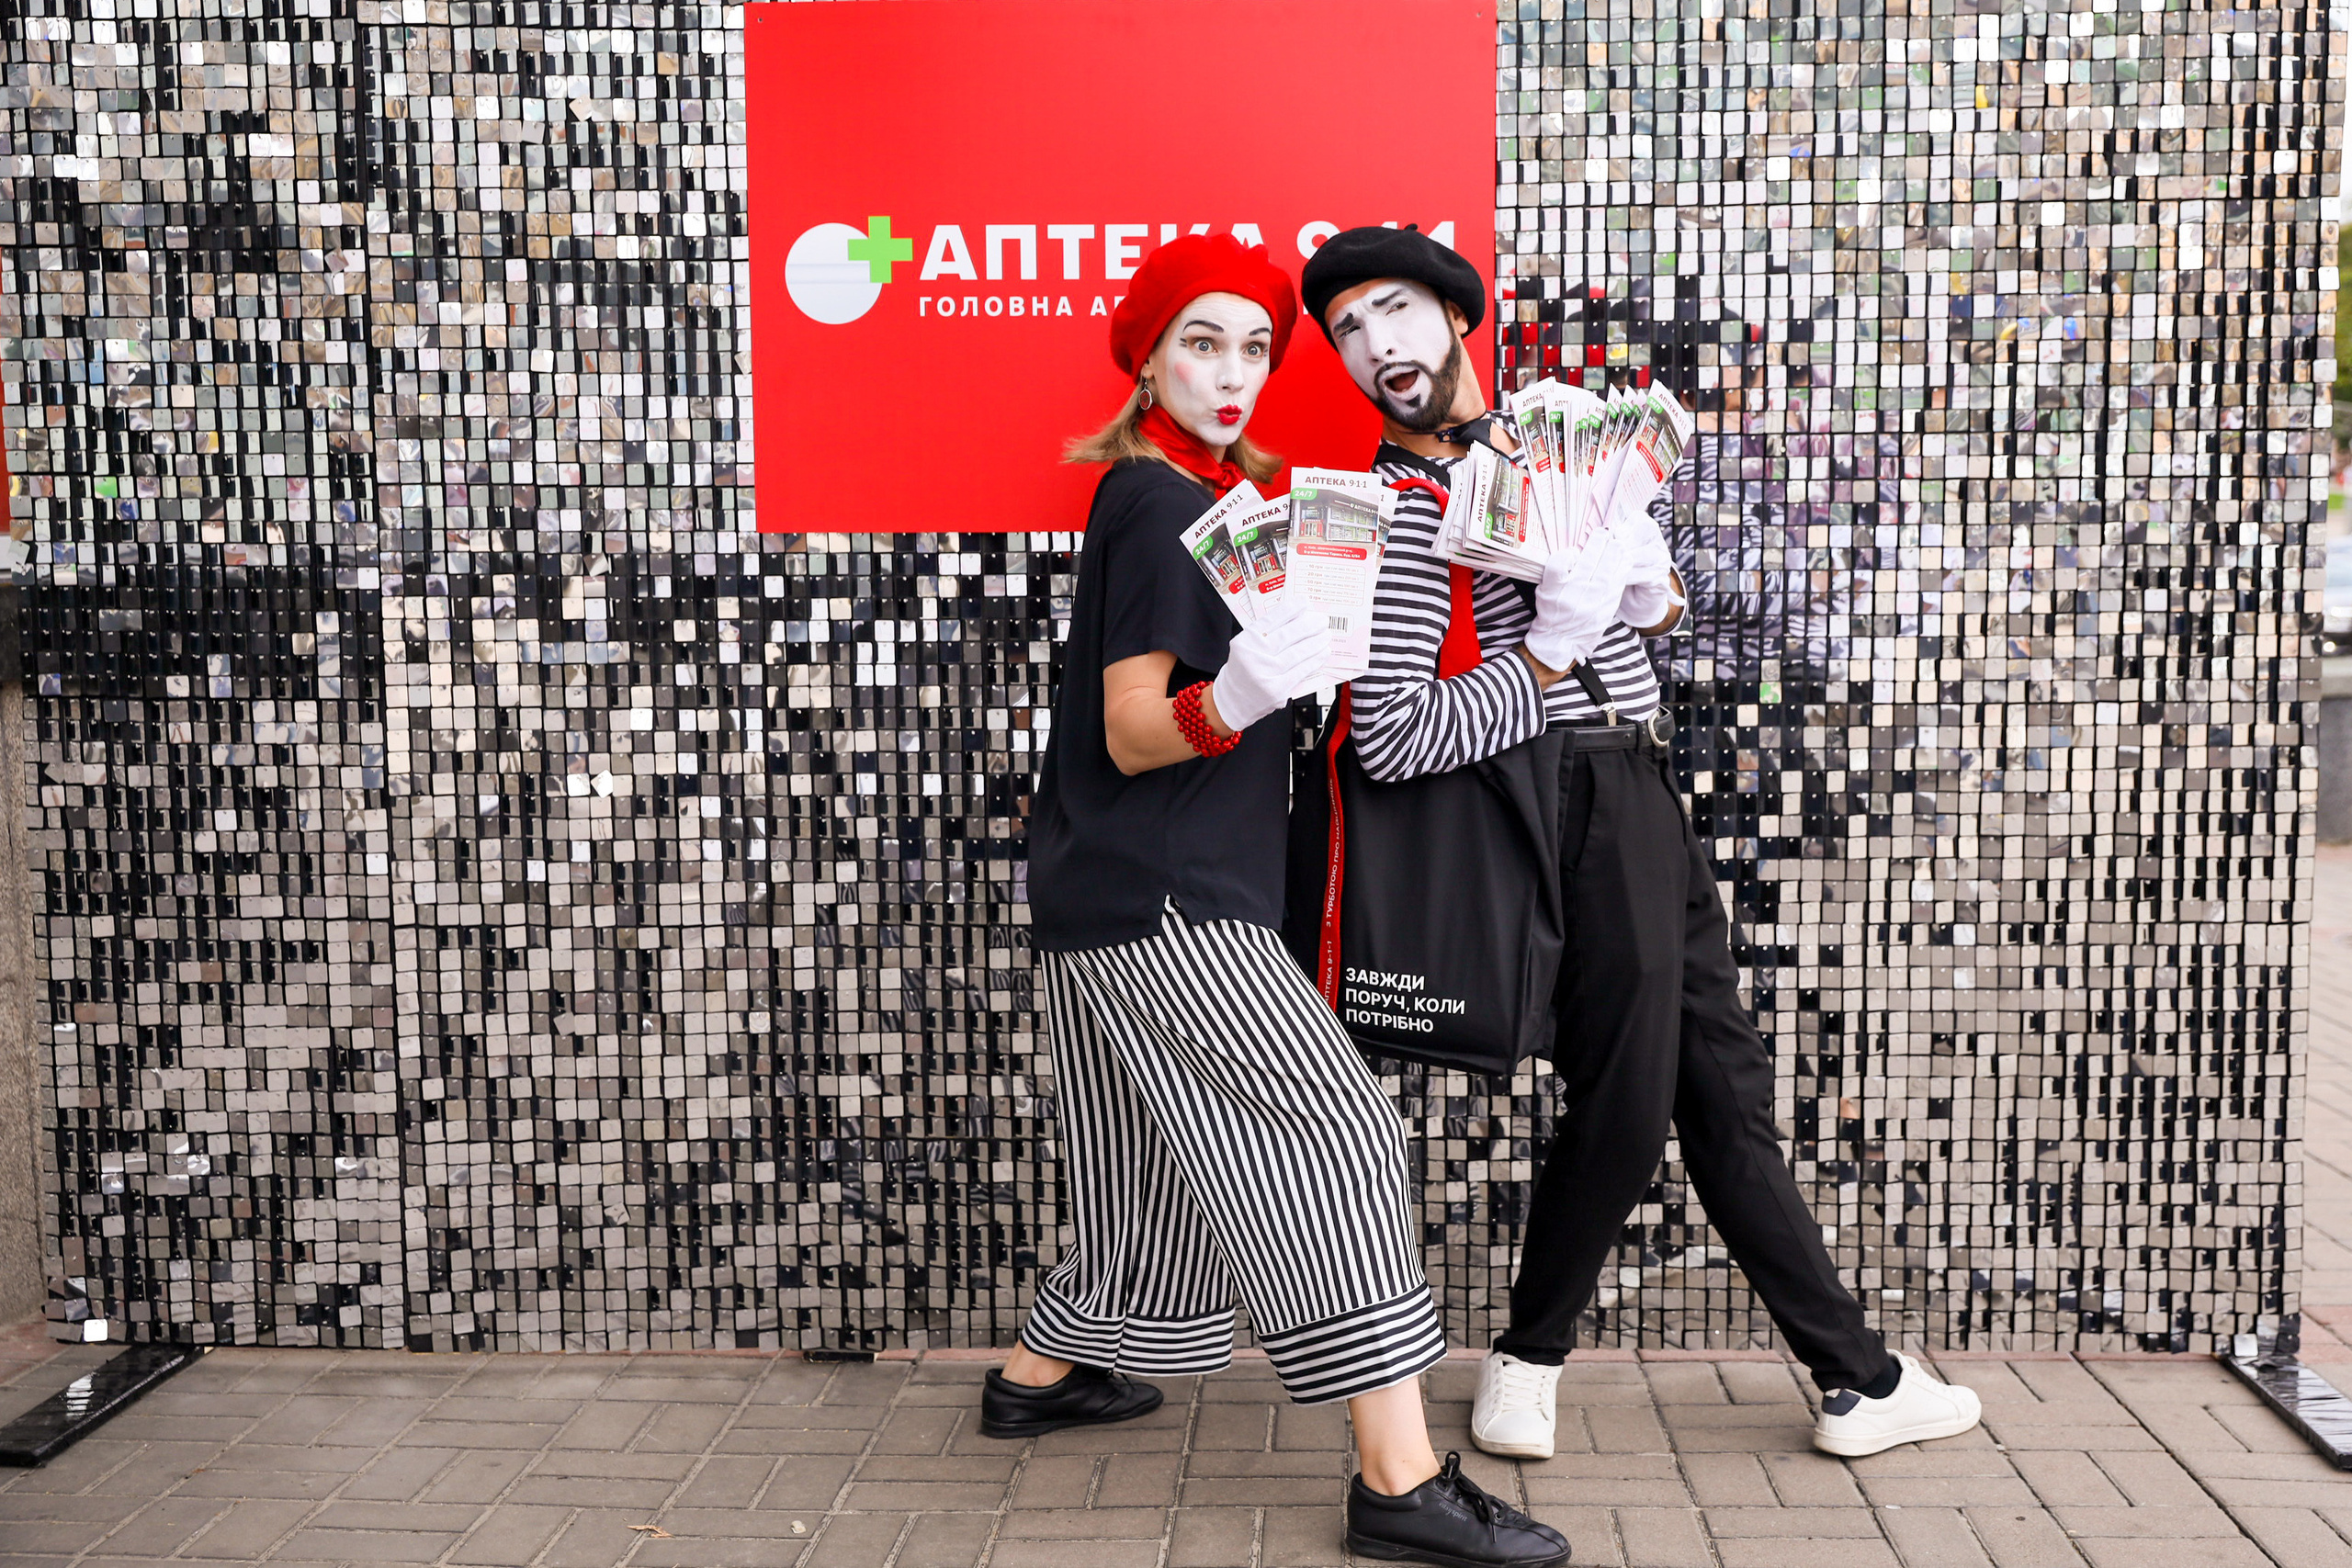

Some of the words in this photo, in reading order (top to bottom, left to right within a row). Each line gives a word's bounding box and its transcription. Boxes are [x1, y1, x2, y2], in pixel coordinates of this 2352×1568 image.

[920, 223, 1270, 280] АПТЕ
[920, 296, 1073, 317] ГОЛОВНА
[1522, 393, 1544, 407] АПТЕКА
[1658, 393, 1679, 417] АПТЕКА
[1305, 477, 1346, 486] АПТЕКА
[1477, 484, 1487, 523] АПТЕКА
[1194, 508, 1227, 538] АПТЕКА
[1241, 506, 1282, 526] АПТЕКА
[1195, 540, 1210, 556] 24/7
[1237, 531, 1254, 543] 24/7
[1327, 865, 1338, 918] ТУРБОТОЮ
[1345, 967, 1425, 992] ЗАВЖДИ
[1345, 987, 1410, 1013] ПОРУЧ,
[1415, 997, 1465, 1015] КОЛИ
[1346, 1008, 1434, 1032] ПОТРІБНО
